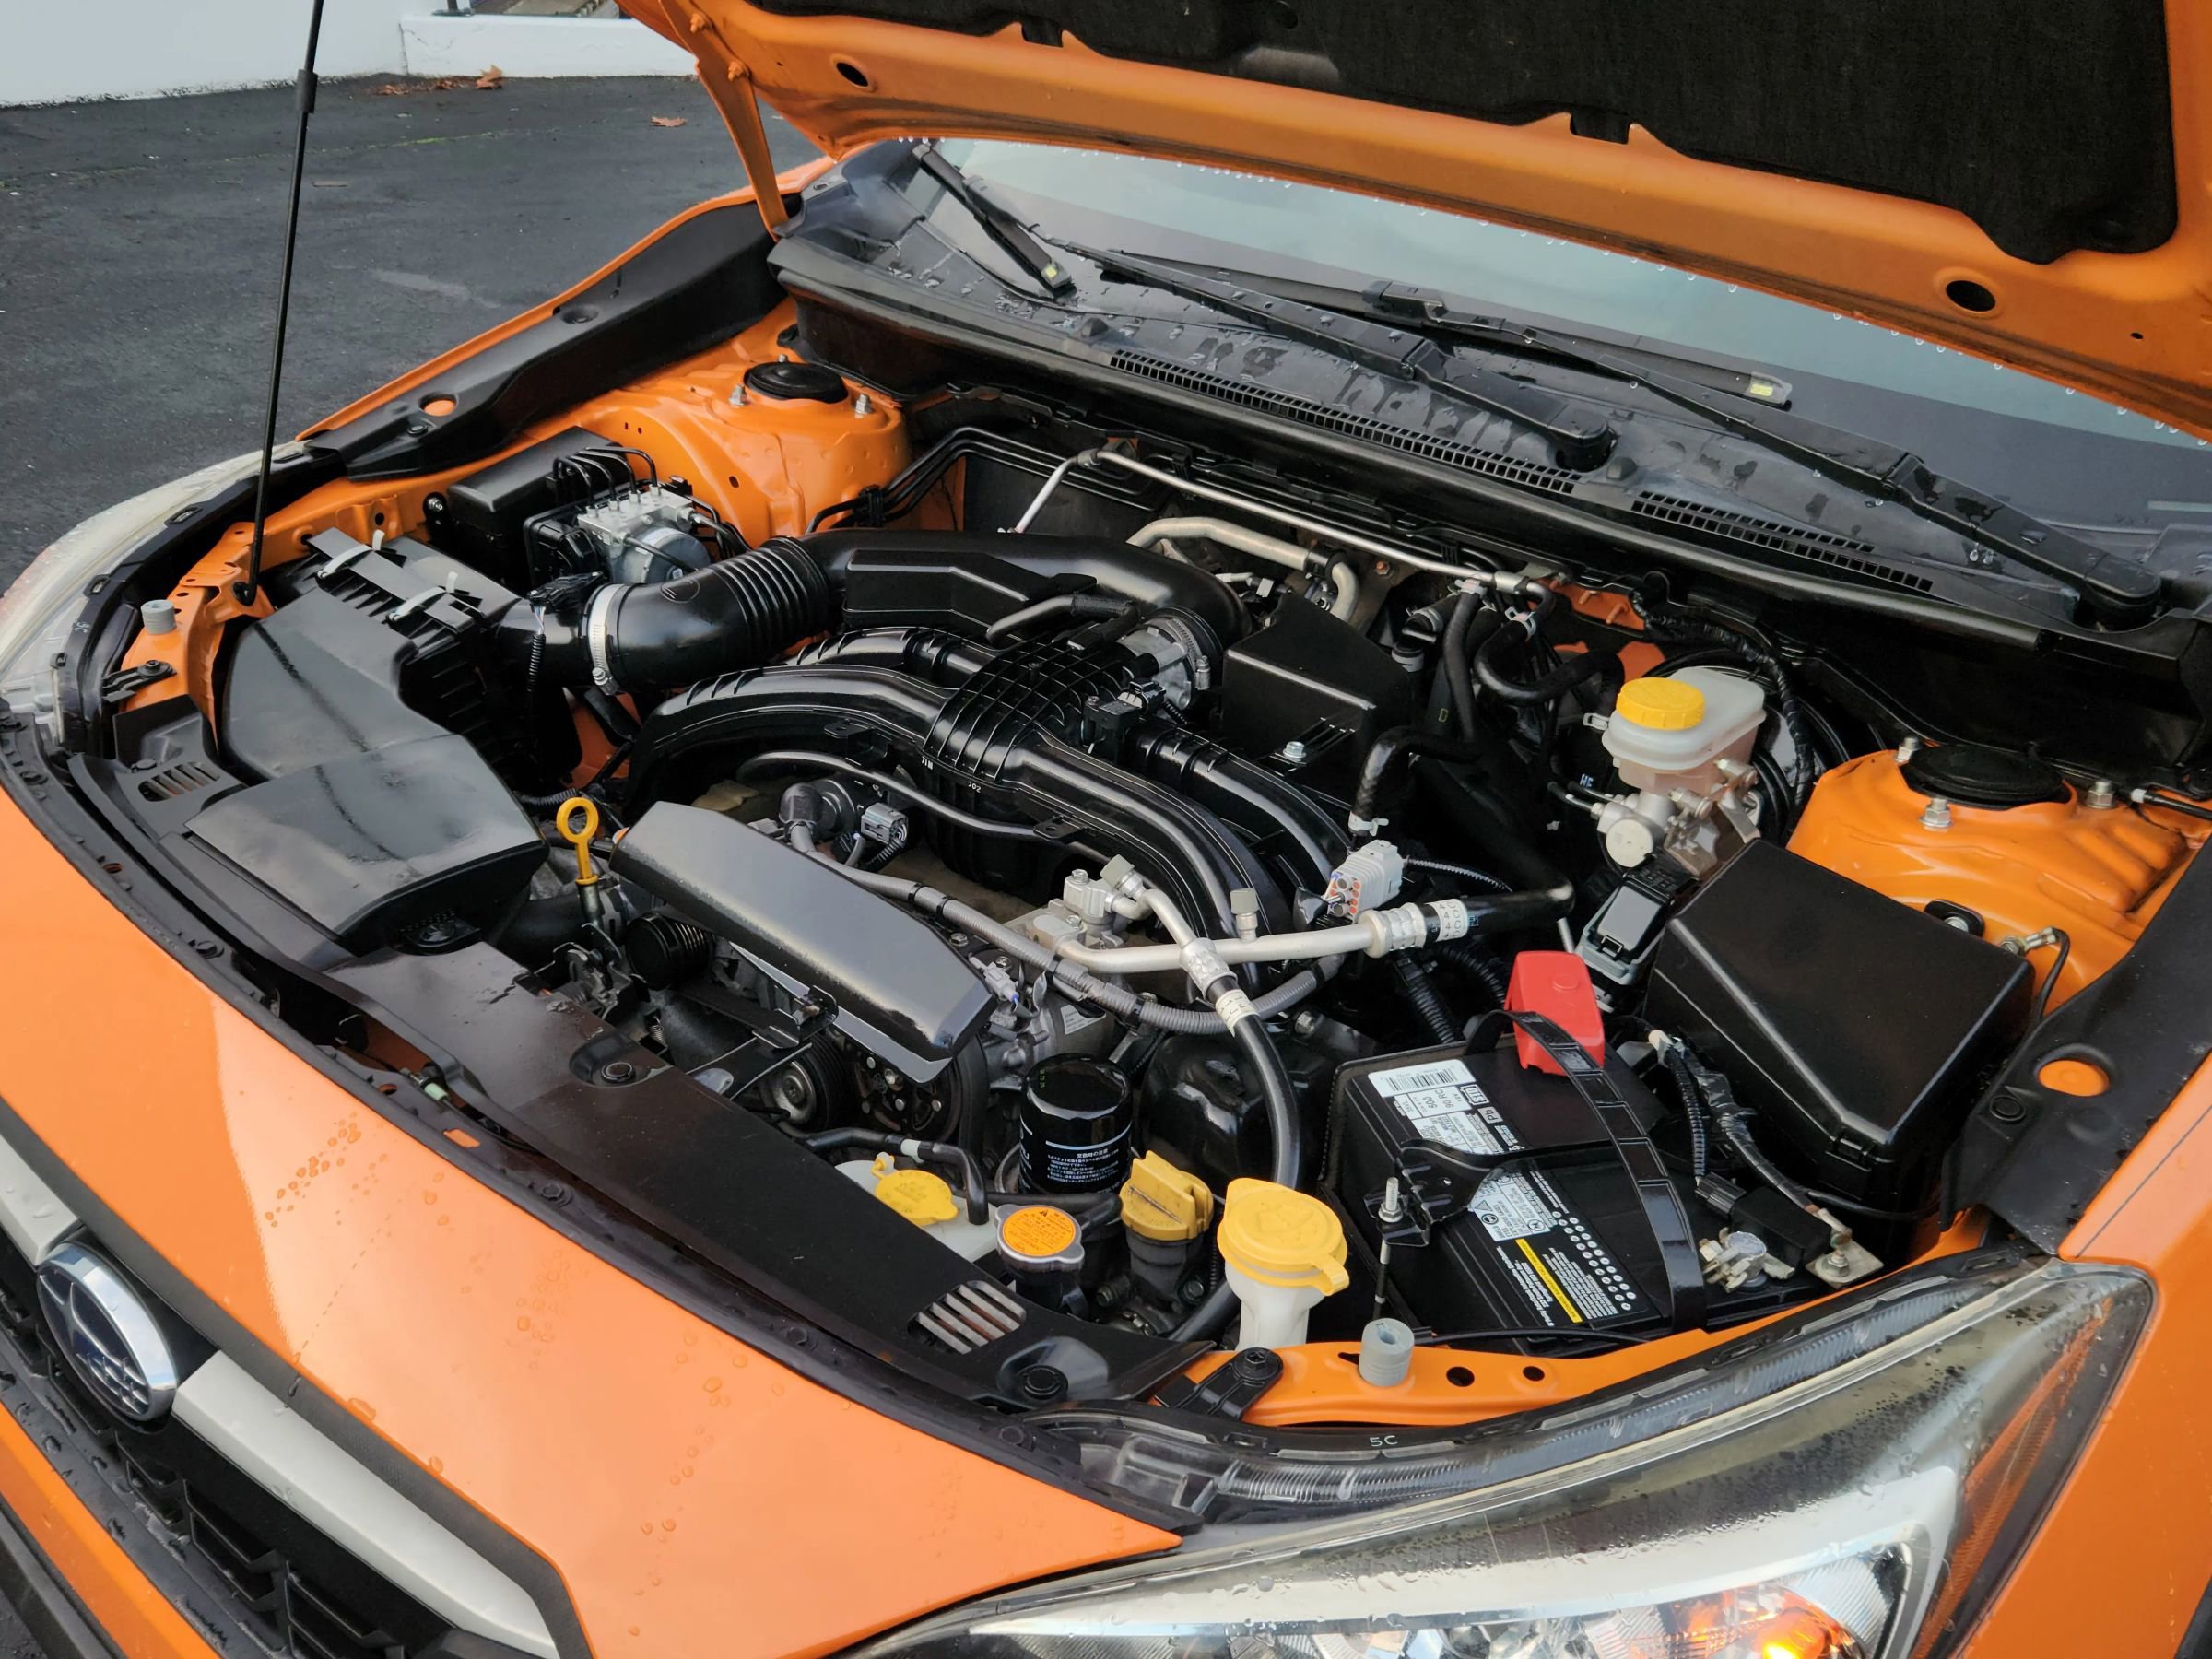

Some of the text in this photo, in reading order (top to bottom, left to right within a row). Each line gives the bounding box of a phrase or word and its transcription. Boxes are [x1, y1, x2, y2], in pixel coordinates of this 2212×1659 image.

[1433, 1088, 1448, 1099] RC
[1421, 1096, 1438, 1108] 500
[1441, 1100, 1454, 1108] 90
[1484, 1109, 1498, 1120] Pb
[1369, 1434, 1398, 1448] 5C
